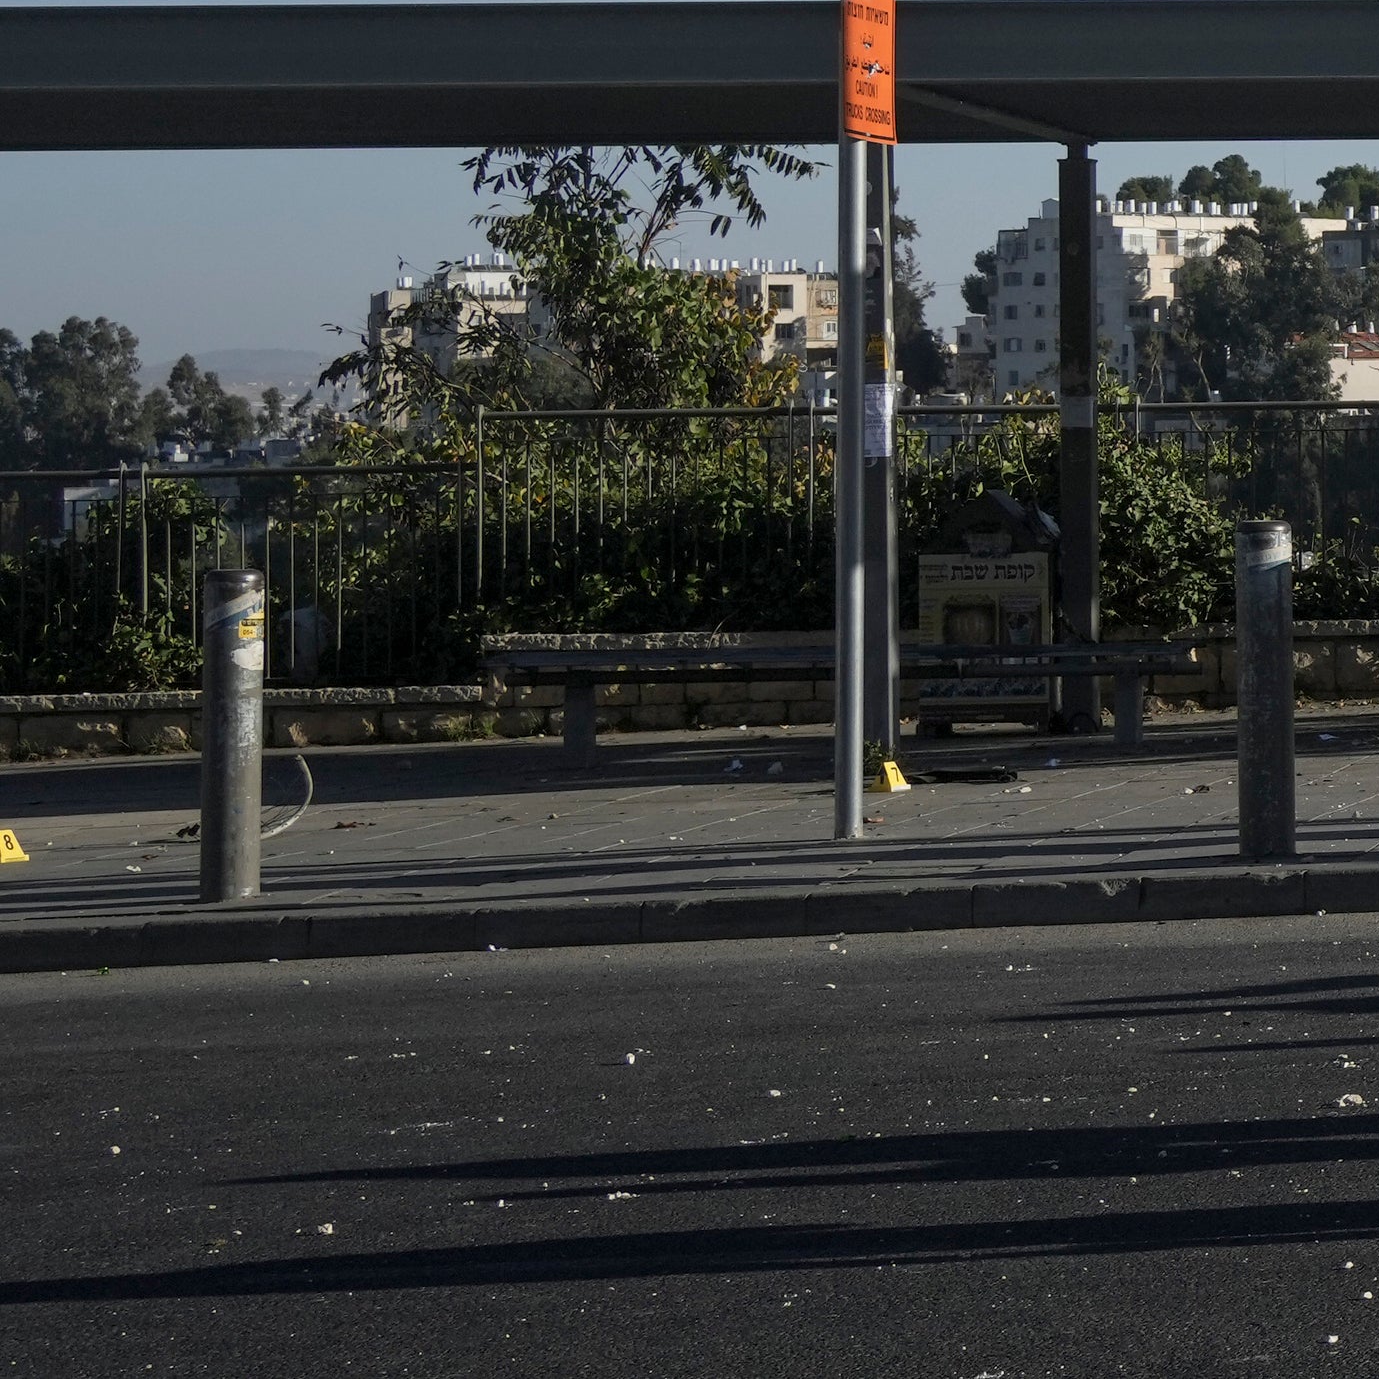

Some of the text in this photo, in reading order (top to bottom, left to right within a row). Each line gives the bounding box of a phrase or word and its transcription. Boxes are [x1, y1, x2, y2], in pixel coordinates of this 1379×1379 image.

[865, 106, 891, 126] CROSSING
[951, 564, 989, 581] שבת
[994, 563, 1036, 583] קופת
[890, 766, 899, 782] 7
[3, 834, 14, 850] 8
